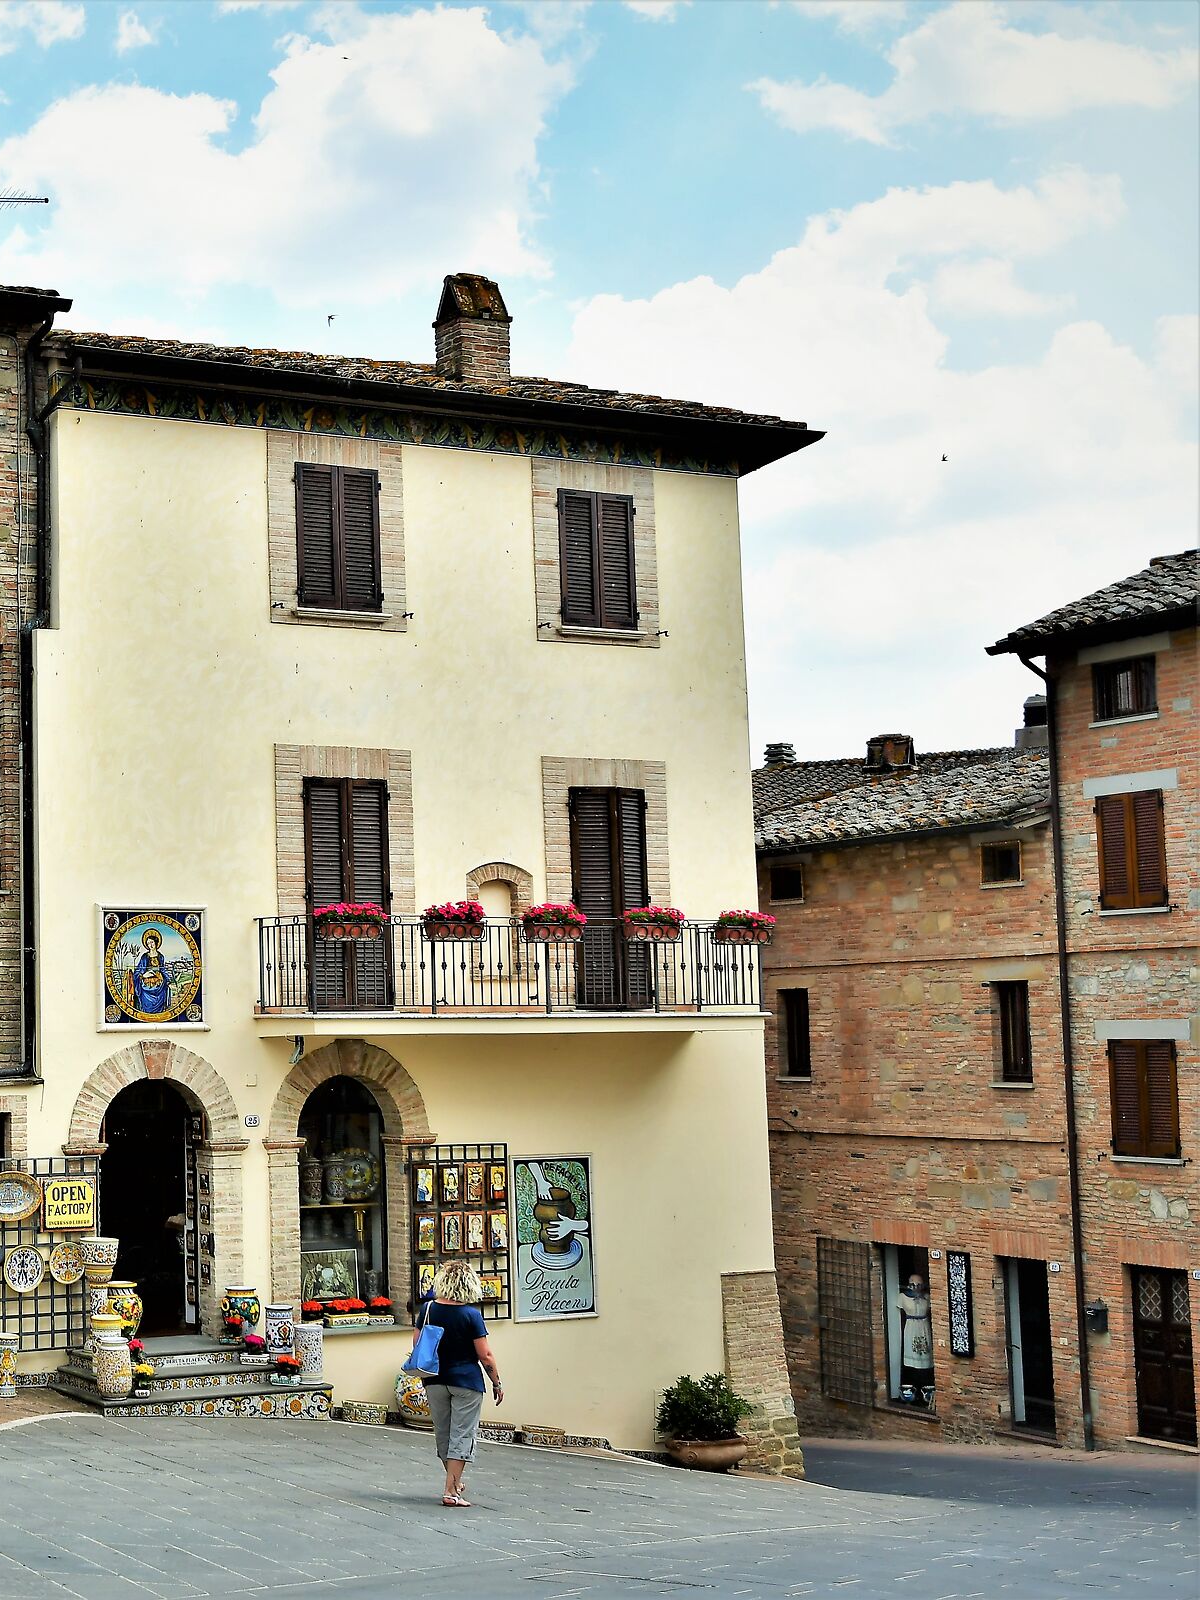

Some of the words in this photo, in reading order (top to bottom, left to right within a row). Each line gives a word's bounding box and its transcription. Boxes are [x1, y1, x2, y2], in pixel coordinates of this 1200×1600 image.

[247, 1116, 258, 1125] 25
[51, 1185, 87, 1202] OPEN
[47, 1202, 92, 1217] FACTORY
[521, 1268, 580, 1290] Deruta
[529, 1290, 587, 1312] Placens
